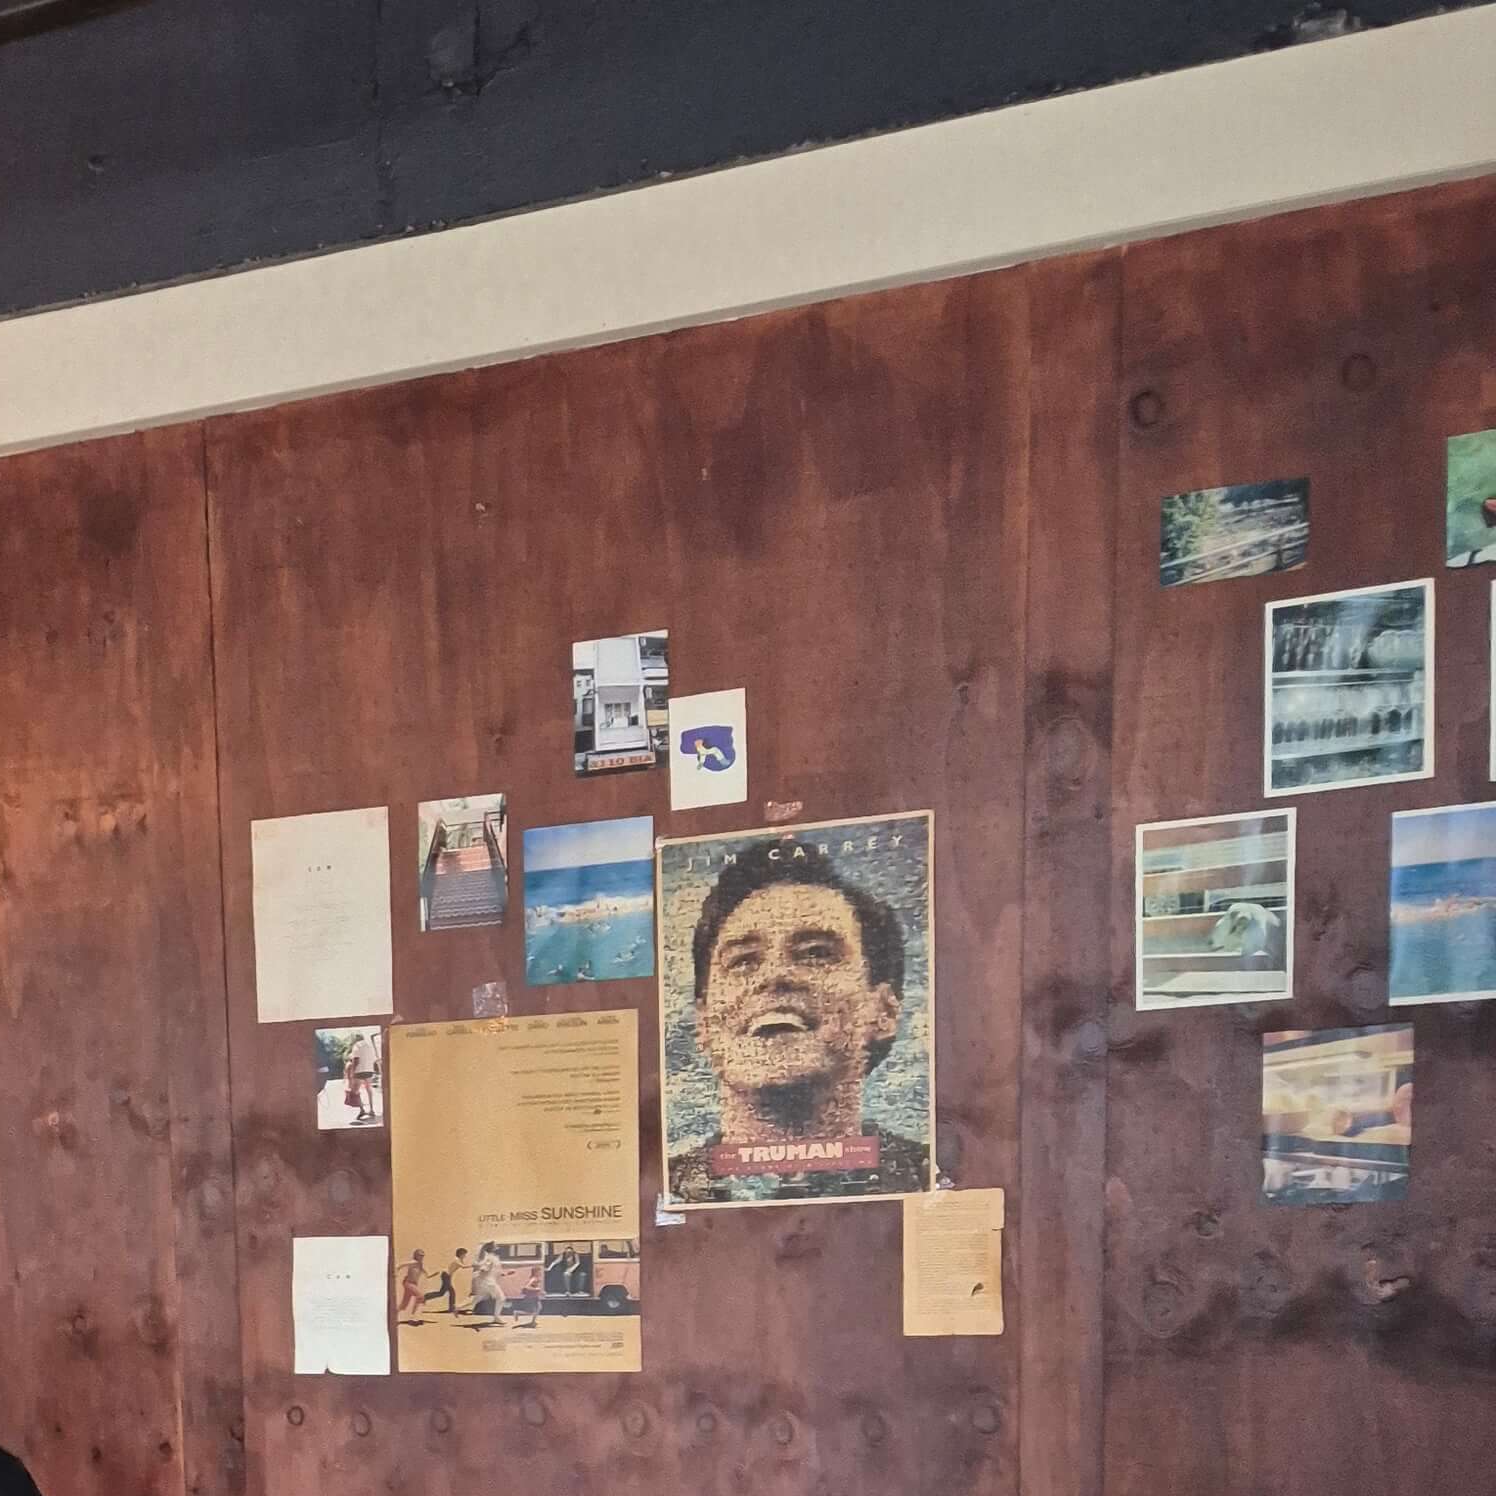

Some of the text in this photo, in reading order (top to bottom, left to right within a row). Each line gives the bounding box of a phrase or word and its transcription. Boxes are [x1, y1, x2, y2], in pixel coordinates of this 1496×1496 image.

[687, 834, 903, 872] JIM CARREY
[738, 1141, 843, 1163] TRUMAN
[479, 1204, 623, 1223] LITTLE MISS SUNSHINE
